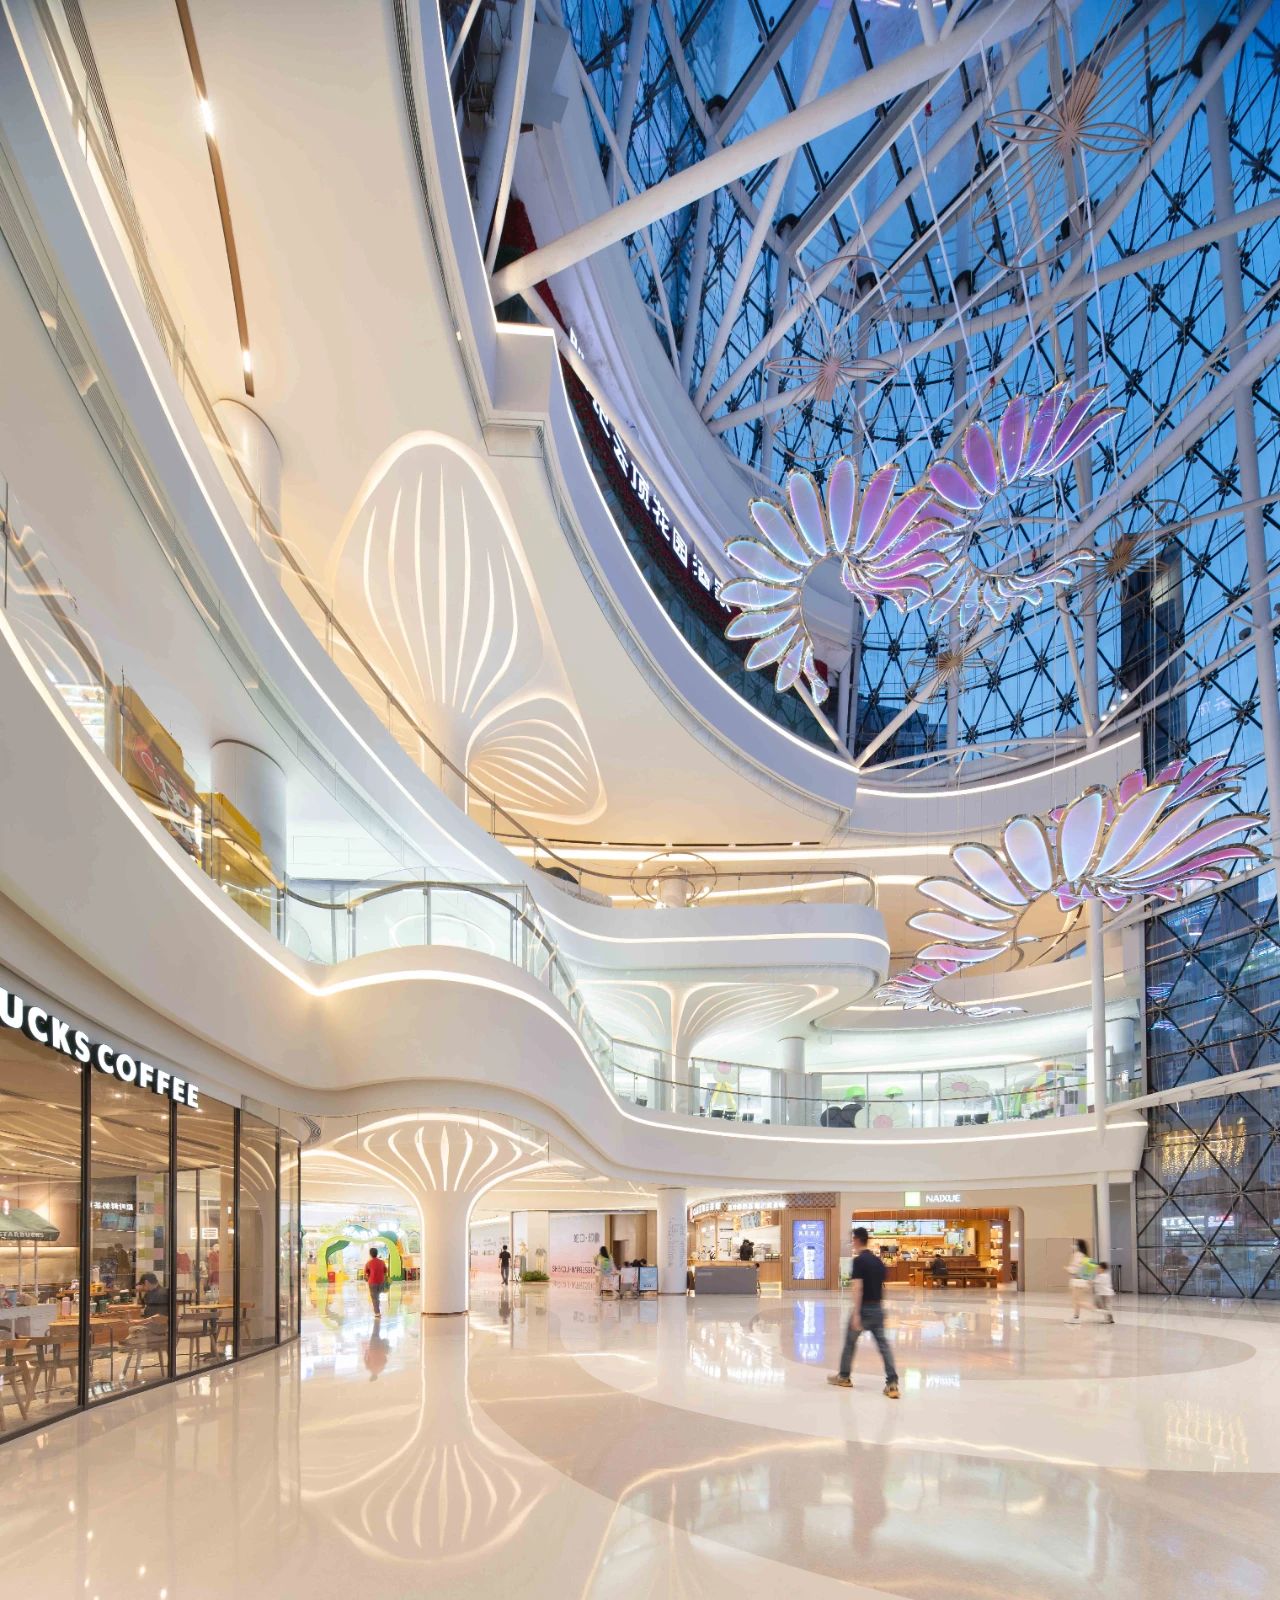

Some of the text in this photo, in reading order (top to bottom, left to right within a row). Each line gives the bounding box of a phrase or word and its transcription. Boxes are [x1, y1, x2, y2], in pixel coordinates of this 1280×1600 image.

[0, 987, 200, 1109] UCKS COFFEE
[925, 1194, 961, 1203] NAIXUE
